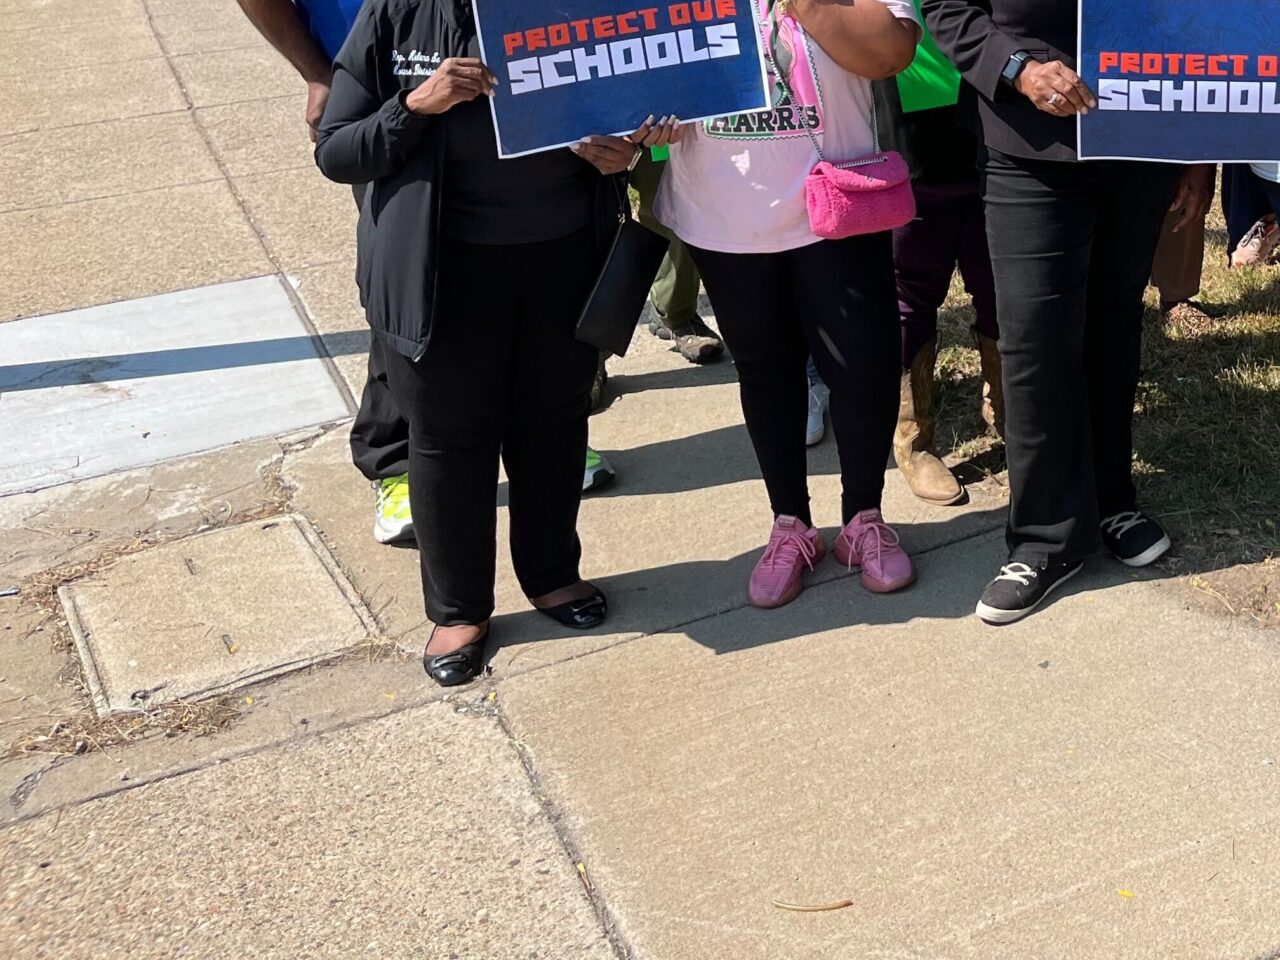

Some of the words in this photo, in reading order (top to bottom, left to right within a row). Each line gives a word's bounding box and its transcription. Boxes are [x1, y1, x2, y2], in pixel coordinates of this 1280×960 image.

[503, 7, 659, 56] PROTECT
[506, 22, 741, 96] SCHOOLS
[1099, 52, 1248, 76] PROTECT
